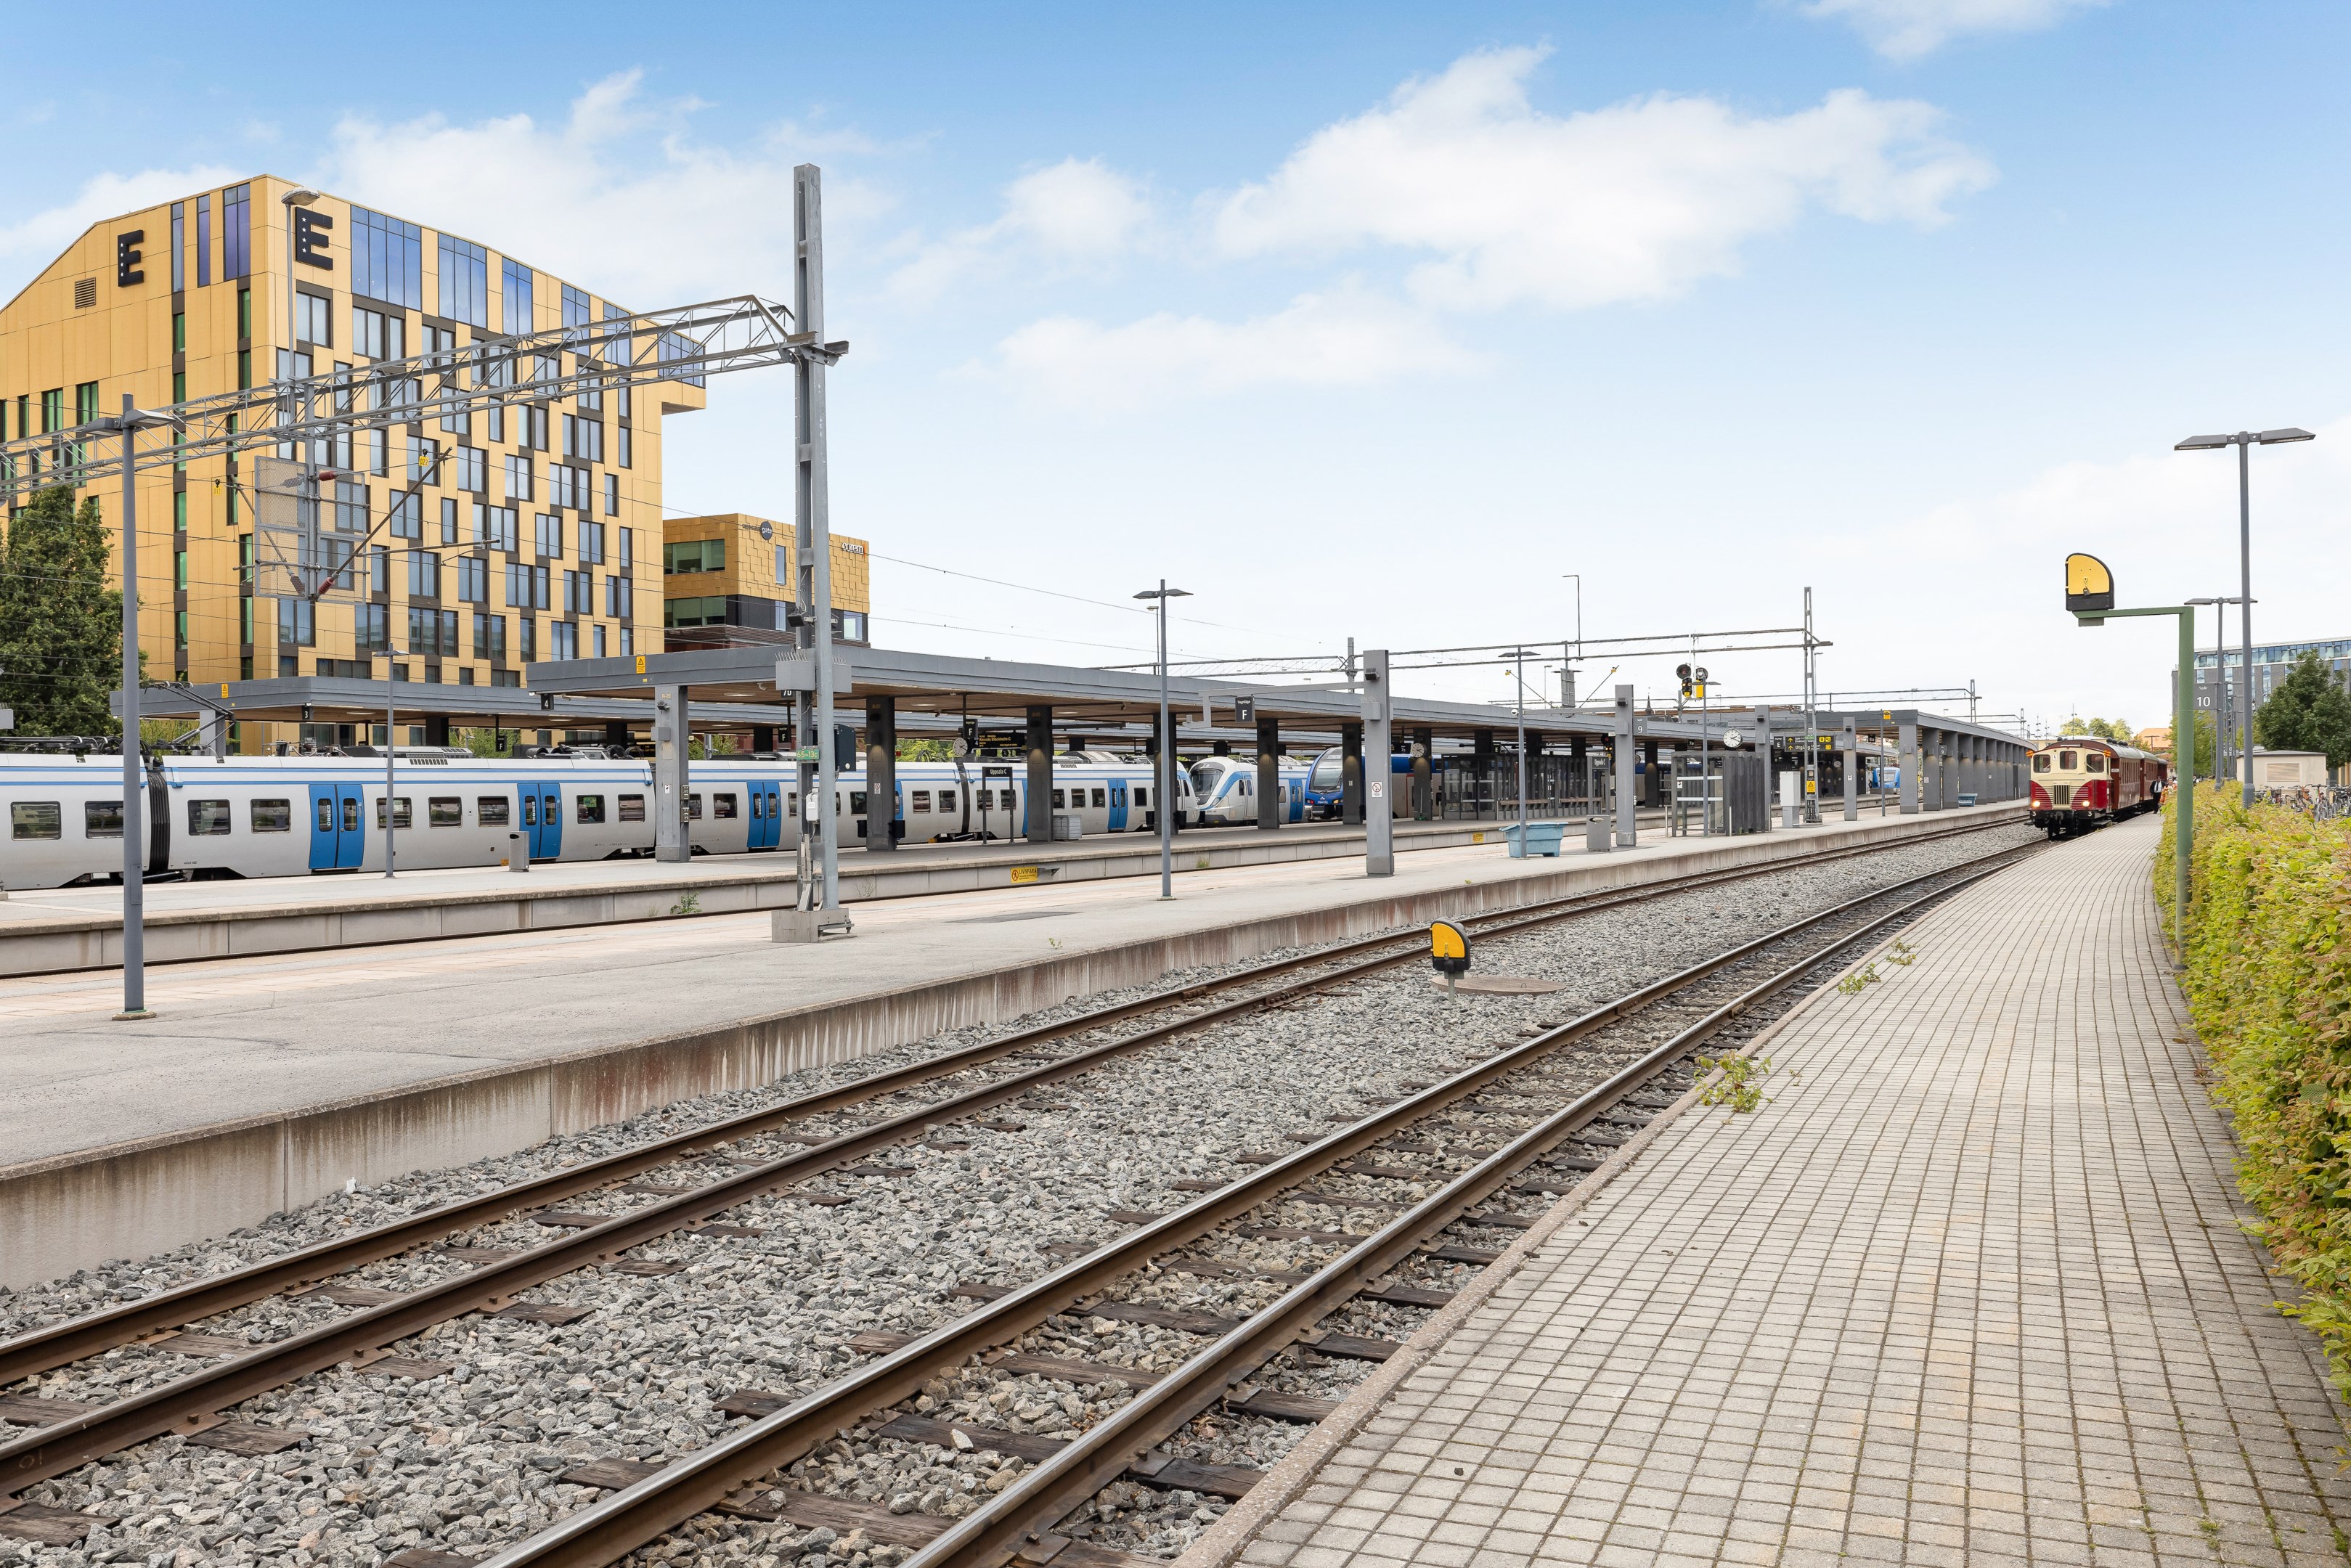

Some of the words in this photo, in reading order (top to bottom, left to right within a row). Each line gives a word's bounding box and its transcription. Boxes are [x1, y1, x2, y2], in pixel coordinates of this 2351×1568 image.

[295, 206, 333, 271] E
[118, 229, 144, 287] E
[842, 542, 864, 555] corem
[545, 700, 549, 709] 4
[2196, 696, 2211, 707] 10
[1242, 709, 1247, 720] F
[1637, 725, 1643, 734] 9
